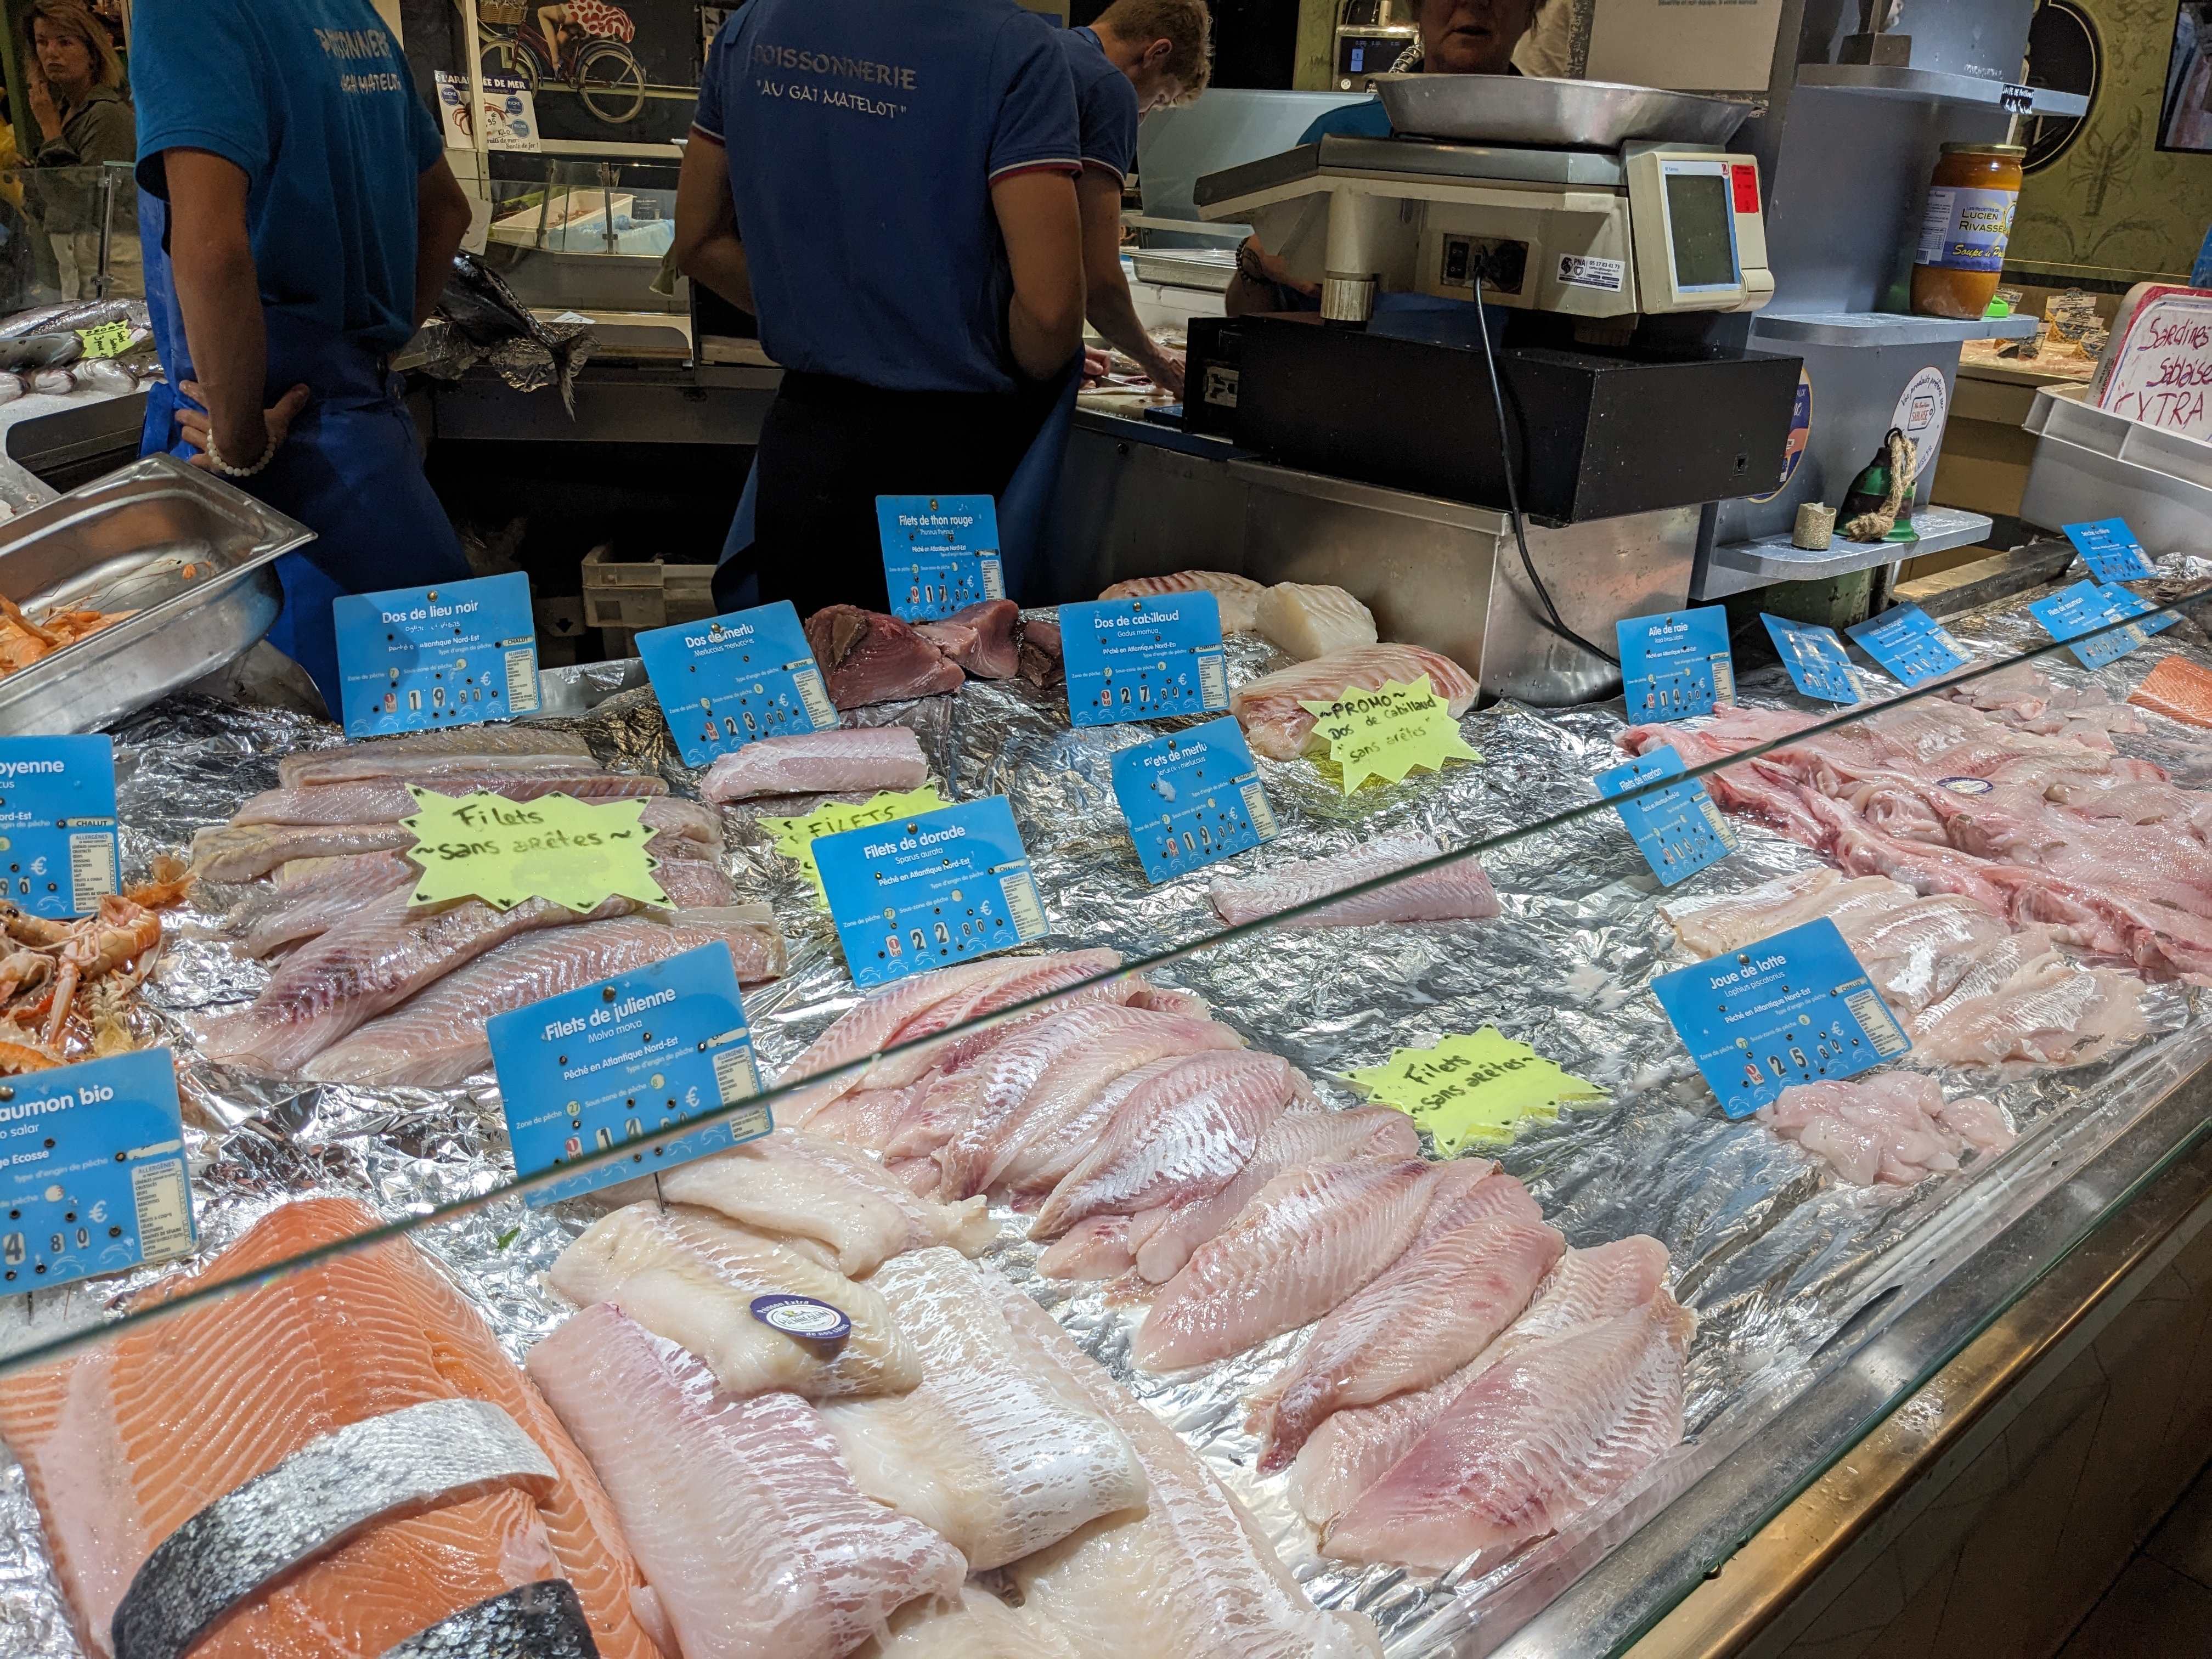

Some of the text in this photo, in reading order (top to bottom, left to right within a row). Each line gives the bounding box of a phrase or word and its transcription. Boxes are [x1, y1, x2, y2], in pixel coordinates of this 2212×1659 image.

[507, 80, 526, 89] MER
[1961, 208, 1998, 220] LUCIEN
[1953, 245, 1983, 259] Soupe
[899, 515, 973, 527] Filets de thon rouge
[382, 600, 478, 624] Dos de lieu noir
[2064, 597, 2084, 609] saumon
[1094, 610, 1179, 629] Dos de cabillaud
[685, 635, 707, 648] Dos
[725, 624, 754, 639] merlu
[1649, 623, 1688, 636] Aile de raie
[453, 634, 479, 644] Nord-Est
[1127, 644, 1154, 652] Atlantique
[695, 645, 724, 657] Merluccius
[1366, 715, 1381, 726] de
[1169, 751, 1181, 760] de
[1182, 741, 1207, 757] merlu
[1619, 768, 1663, 791] Filets de merlan
[452, 804, 544, 827] Filets
[864, 825, 966, 860] Filets de dorade
[895, 848, 944, 865] Sparus aurata
[878, 877, 899, 887] Pêché
[910, 865, 943, 879] Atlantique
[943, 857, 970, 870] Nord-Est
[1710, 953, 1787, 990] Joue de lotte
[1724, 971, 1785, 998] Lophius piscatorius
[1842, 980, 1861, 992] CHALUT
[1724, 987, 1812, 1024] Pêché en Atlantique Nord-Est
[545, 988, 676, 1042] Filets de julienne
[588, 1029, 615, 1043] Molva
[564, 1036, 679, 1080] Pêché en Atlantique Nord-Est
[626, 1064, 641, 1075] Type
[674, 1046, 695, 1059] pêche
[1403, 1054, 1472, 1085] Filets
[80, 1085, 114, 1107] bio
[568, 1103, 579, 1114] 27
[516, 1118, 533, 1130] Zone
[544, 1111, 563, 1123] pêche
[10, 1123, 40, 1137] salar
[12, 1149, 50, 1165] Ecosse
[138, 1161, 175, 1174] ALLERGÈNES
